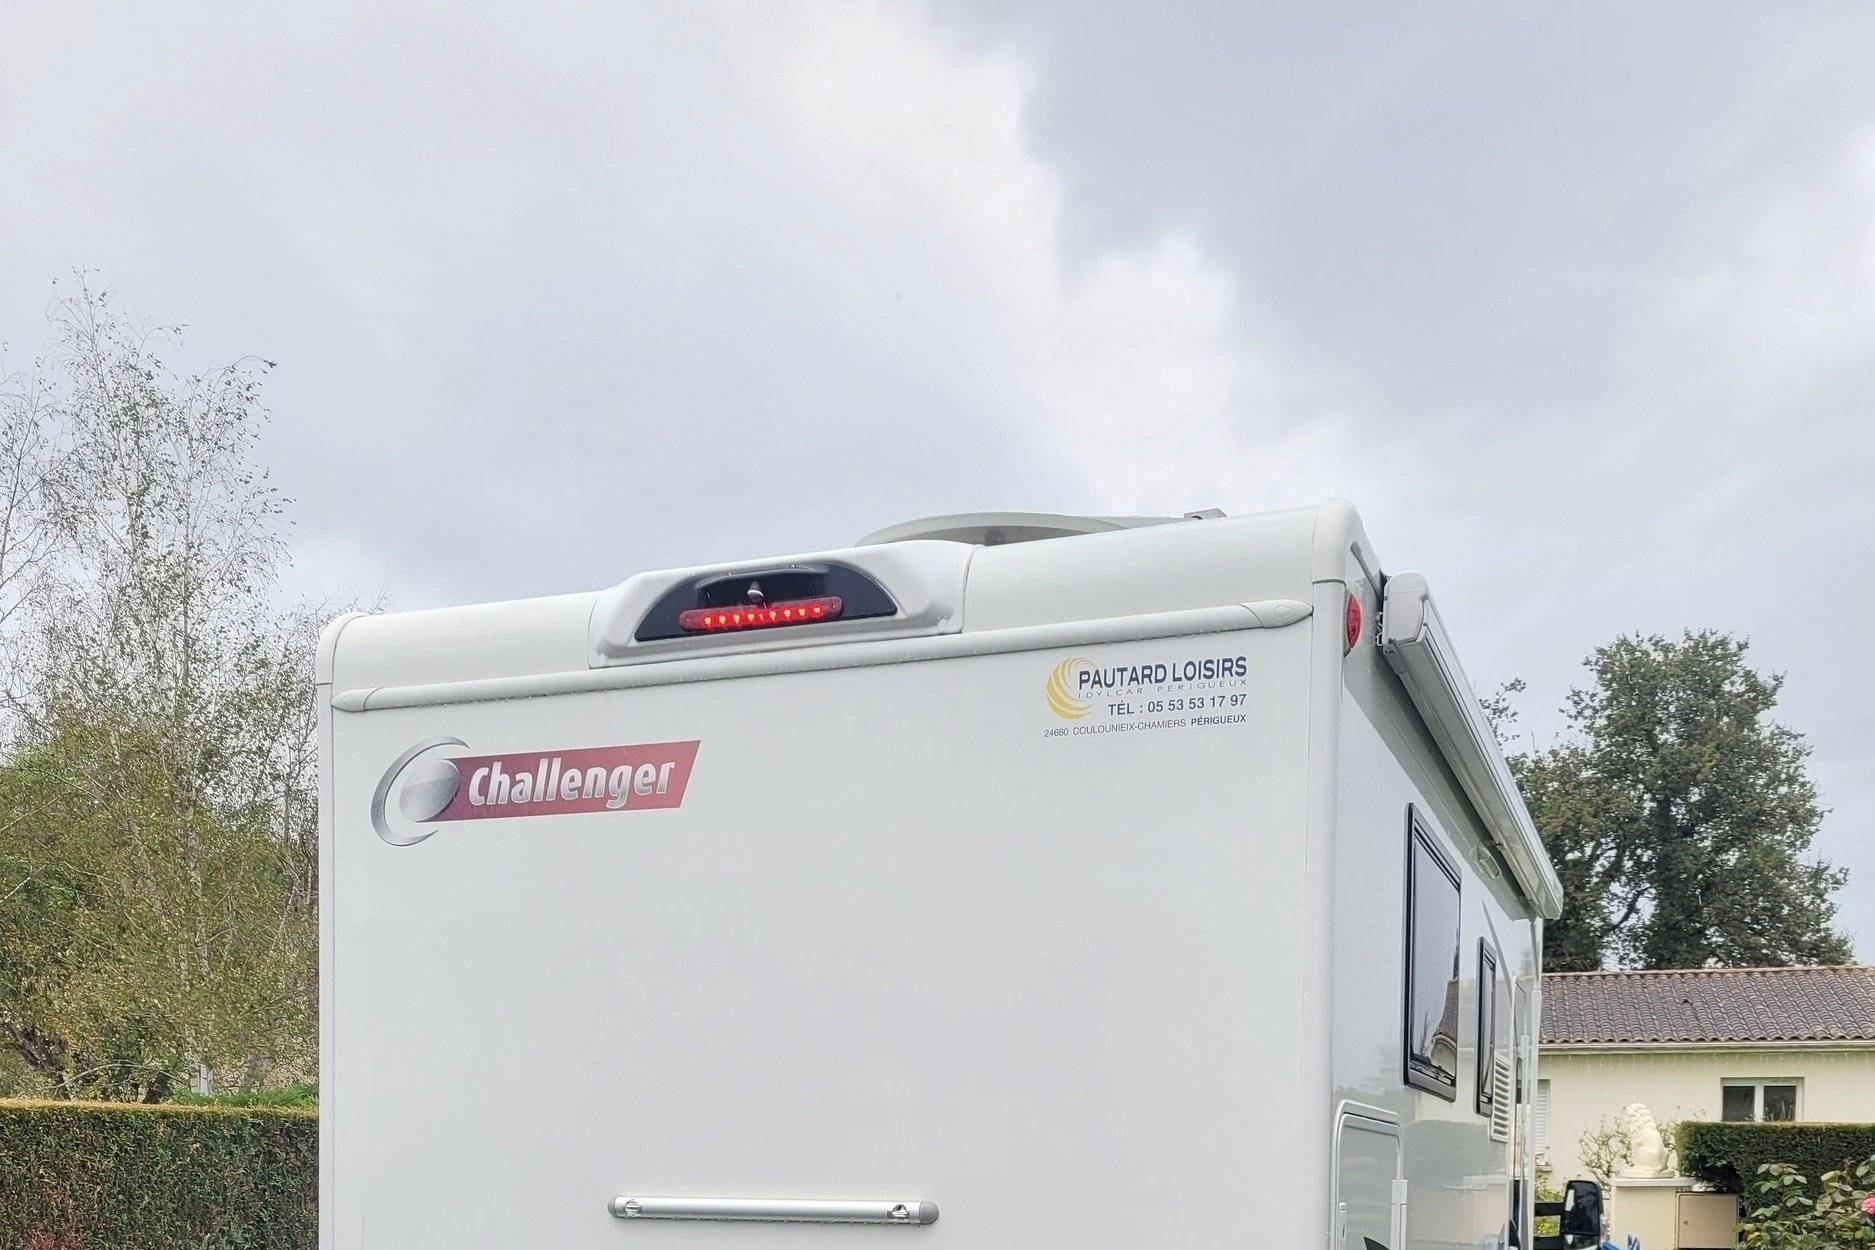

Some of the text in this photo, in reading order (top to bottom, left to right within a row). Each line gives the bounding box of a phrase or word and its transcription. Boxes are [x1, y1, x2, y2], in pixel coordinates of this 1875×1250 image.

[1078, 656, 1247, 690] PAUTARD LOISIRS
[1078, 687, 1143, 700] IDYLCAR
[1108, 700, 1135, 716] TÉL
[1147, 701, 1164, 713] 05
[1168, 699, 1184, 711] 53
[1188, 697, 1205, 710] 53
[1209, 695, 1226, 707] 17
[1230, 693, 1247, 706] 97
[1044, 714, 1247, 738] 24660 COULOUNIEIX-CHAMIERS PÉRIGUEUX
[468, 757, 676, 809] Challenger
